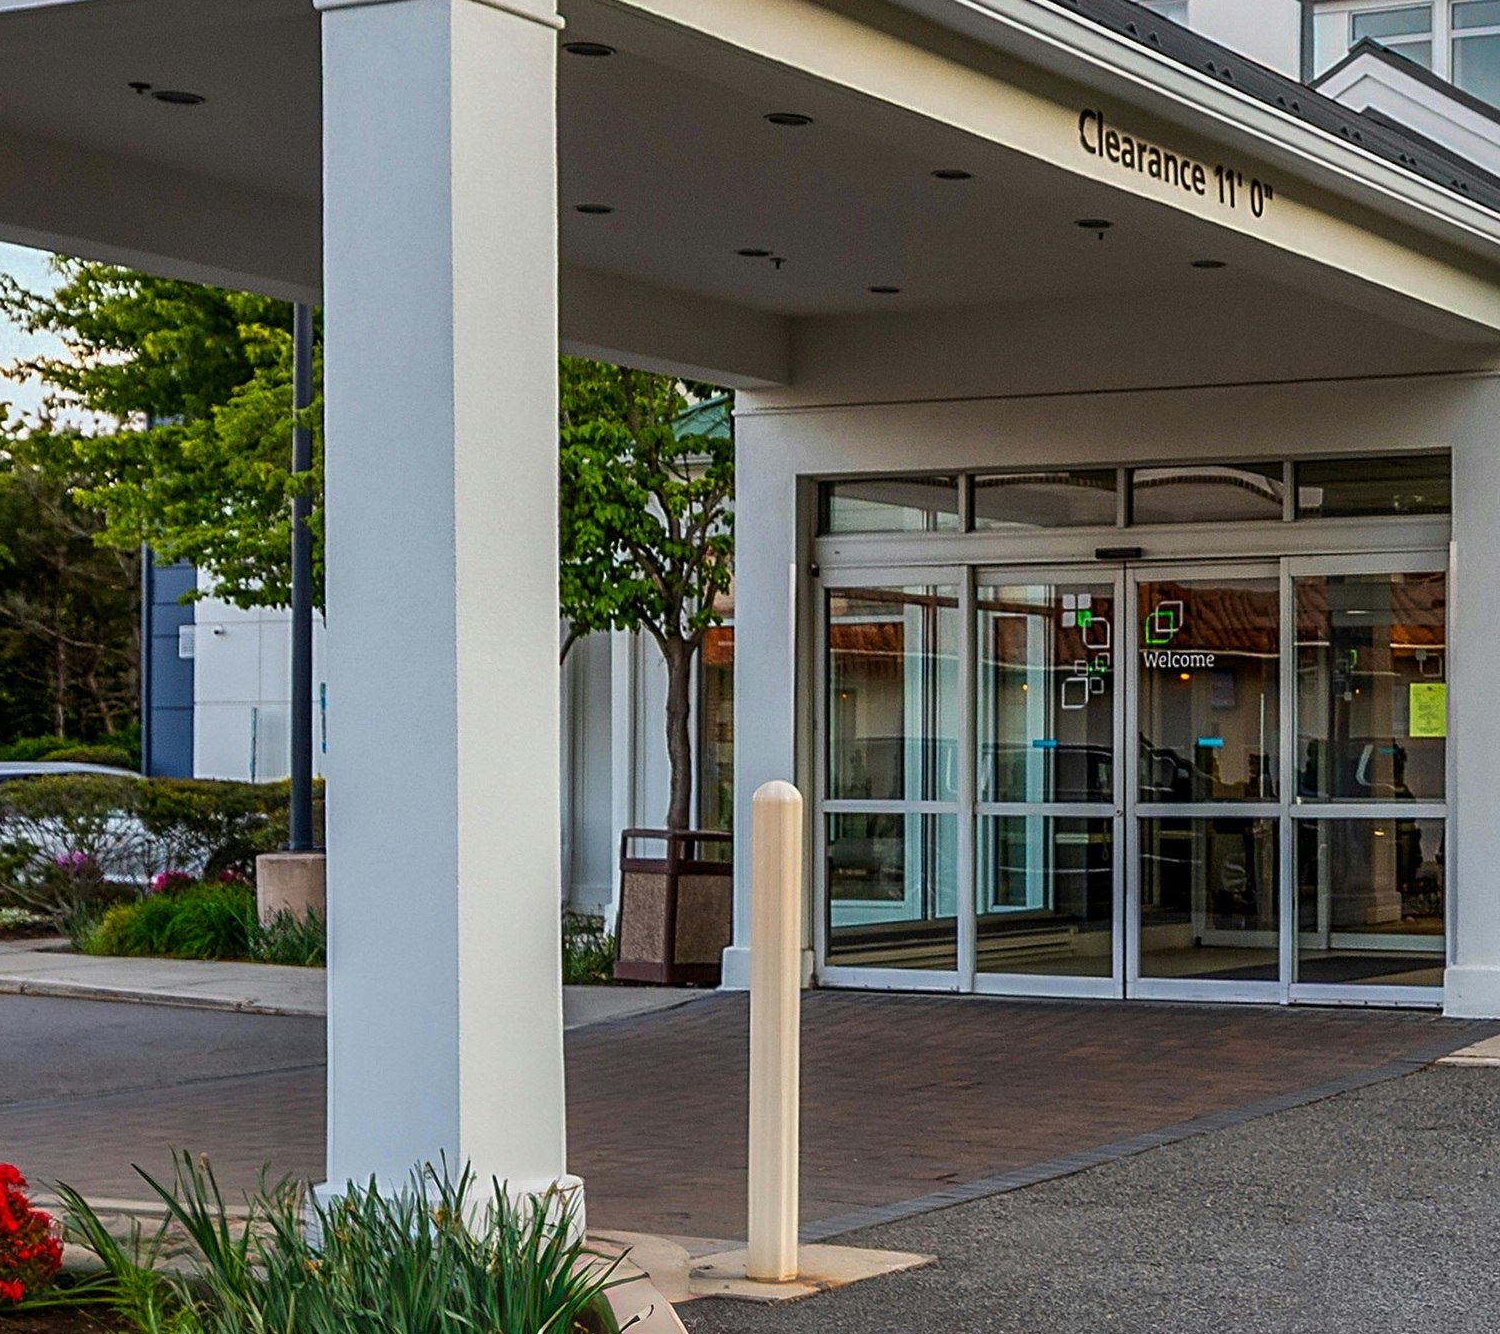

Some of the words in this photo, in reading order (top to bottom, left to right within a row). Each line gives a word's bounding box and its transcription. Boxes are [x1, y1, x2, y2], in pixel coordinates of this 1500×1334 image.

[1079, 109, 1206, 195] Clearance
[1214, 165, 1242, 208] 11'
[1251, 179, 1273, 218] 0"
[1143, 651, 1215, 668] Welcome
